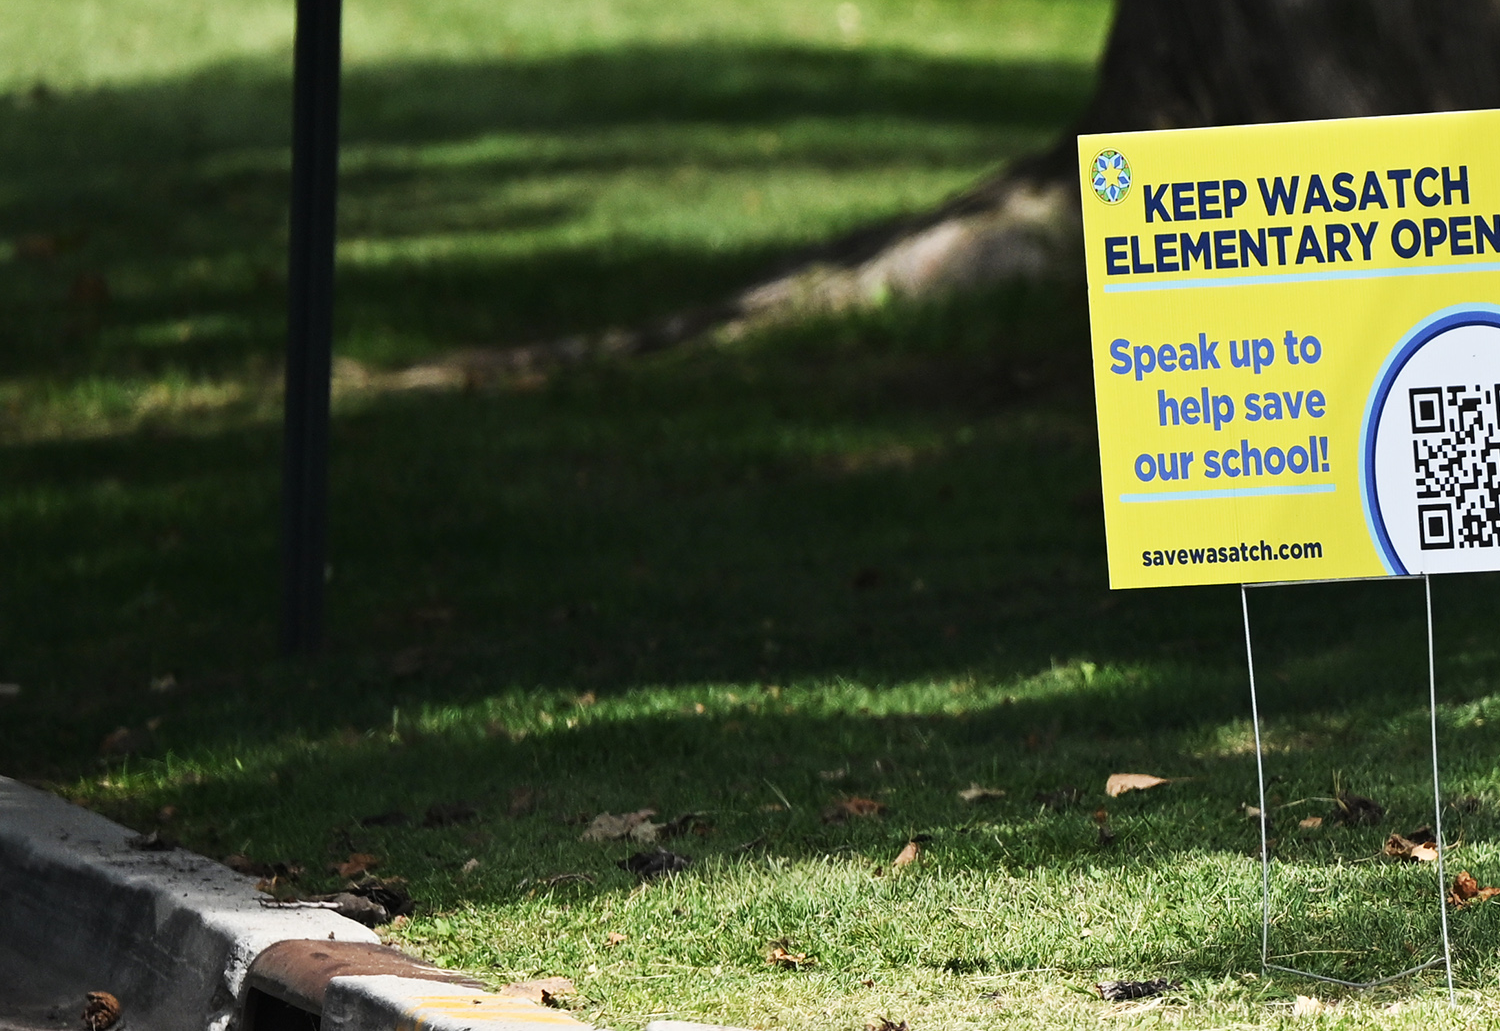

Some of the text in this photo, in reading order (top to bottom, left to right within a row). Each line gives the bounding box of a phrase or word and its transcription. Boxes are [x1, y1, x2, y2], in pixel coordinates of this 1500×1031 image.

[1143, 165, 1470, 223] KEEP WASATCH
[1105, 222, 1379, 275] ELEMENTARY
[1110, 331, 1322, 381] Speak up to
[1158, 387, 1326, 430] help save
[1135, 436, 1330, 482] our school!
[1142, 540, 1323, 567] savewasatch.com
